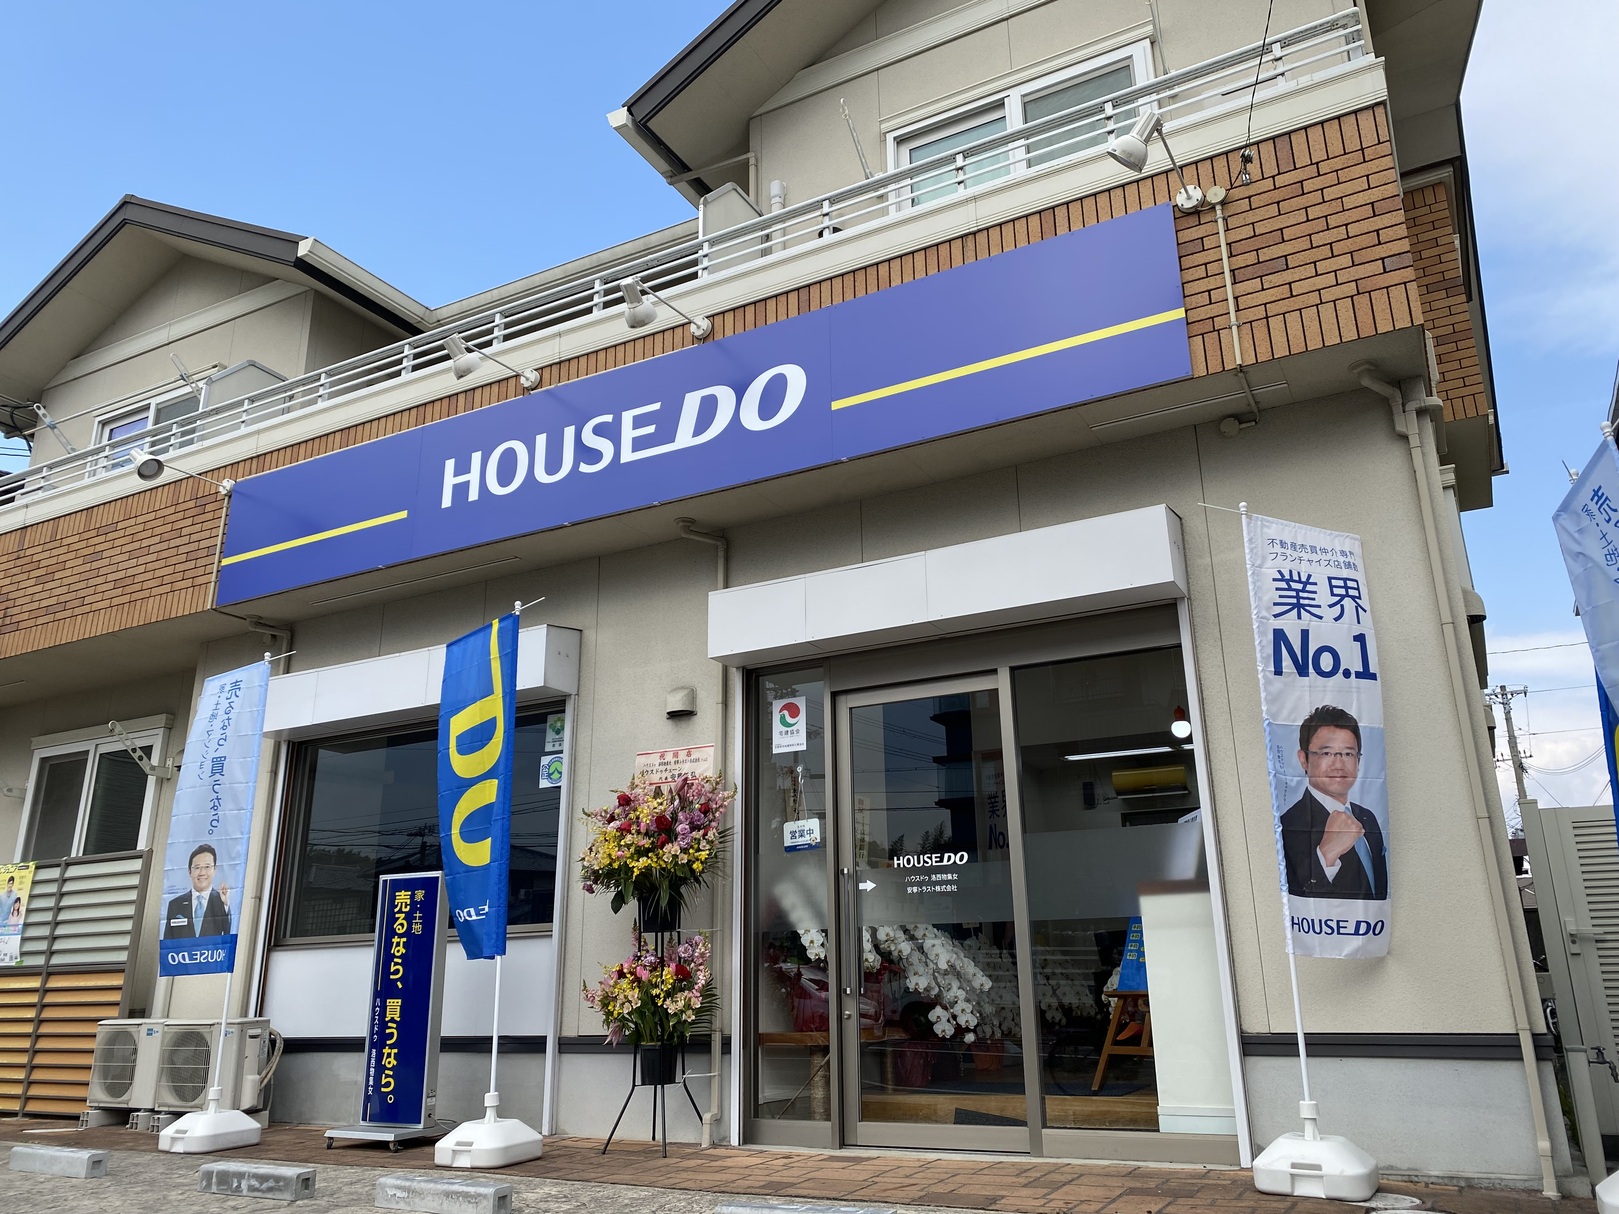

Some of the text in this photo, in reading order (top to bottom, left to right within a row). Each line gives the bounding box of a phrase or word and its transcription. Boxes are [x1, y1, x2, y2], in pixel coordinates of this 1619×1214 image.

[1272, 569, 1367, 625] 業界
[1272, 628, 1378, 682] No.1
[789, 828, 814, 840] 営業中
[411, 889, 425, 935] 家・土地
